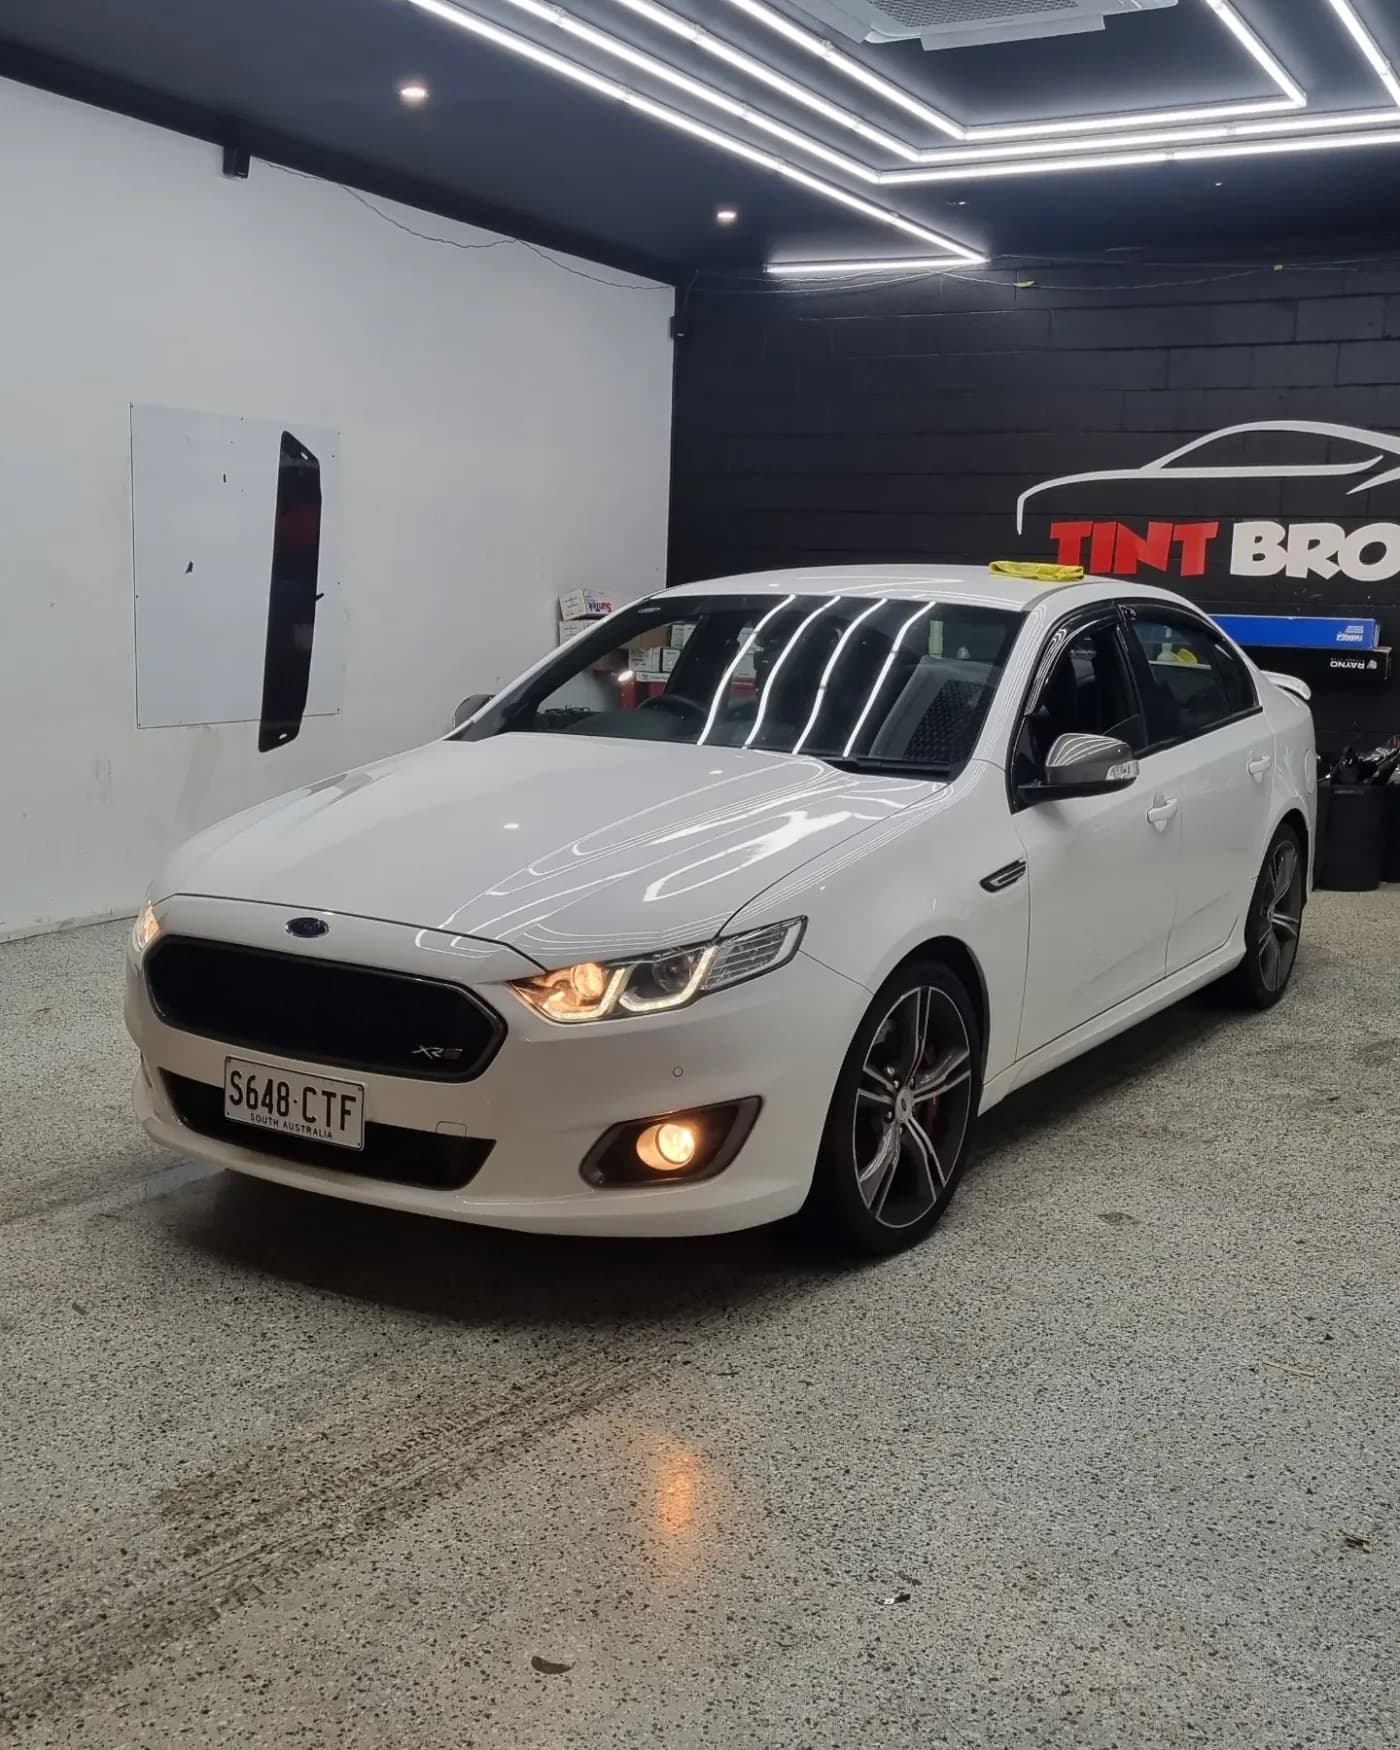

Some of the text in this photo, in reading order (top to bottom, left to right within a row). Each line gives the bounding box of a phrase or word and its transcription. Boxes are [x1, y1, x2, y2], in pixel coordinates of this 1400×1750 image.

[1050, 521, 1219, 576] TINT
[1330, 660, 1365, 670] RAYNO
[250, 1112, 333, 1140] SOUTH AUSTRALIA
